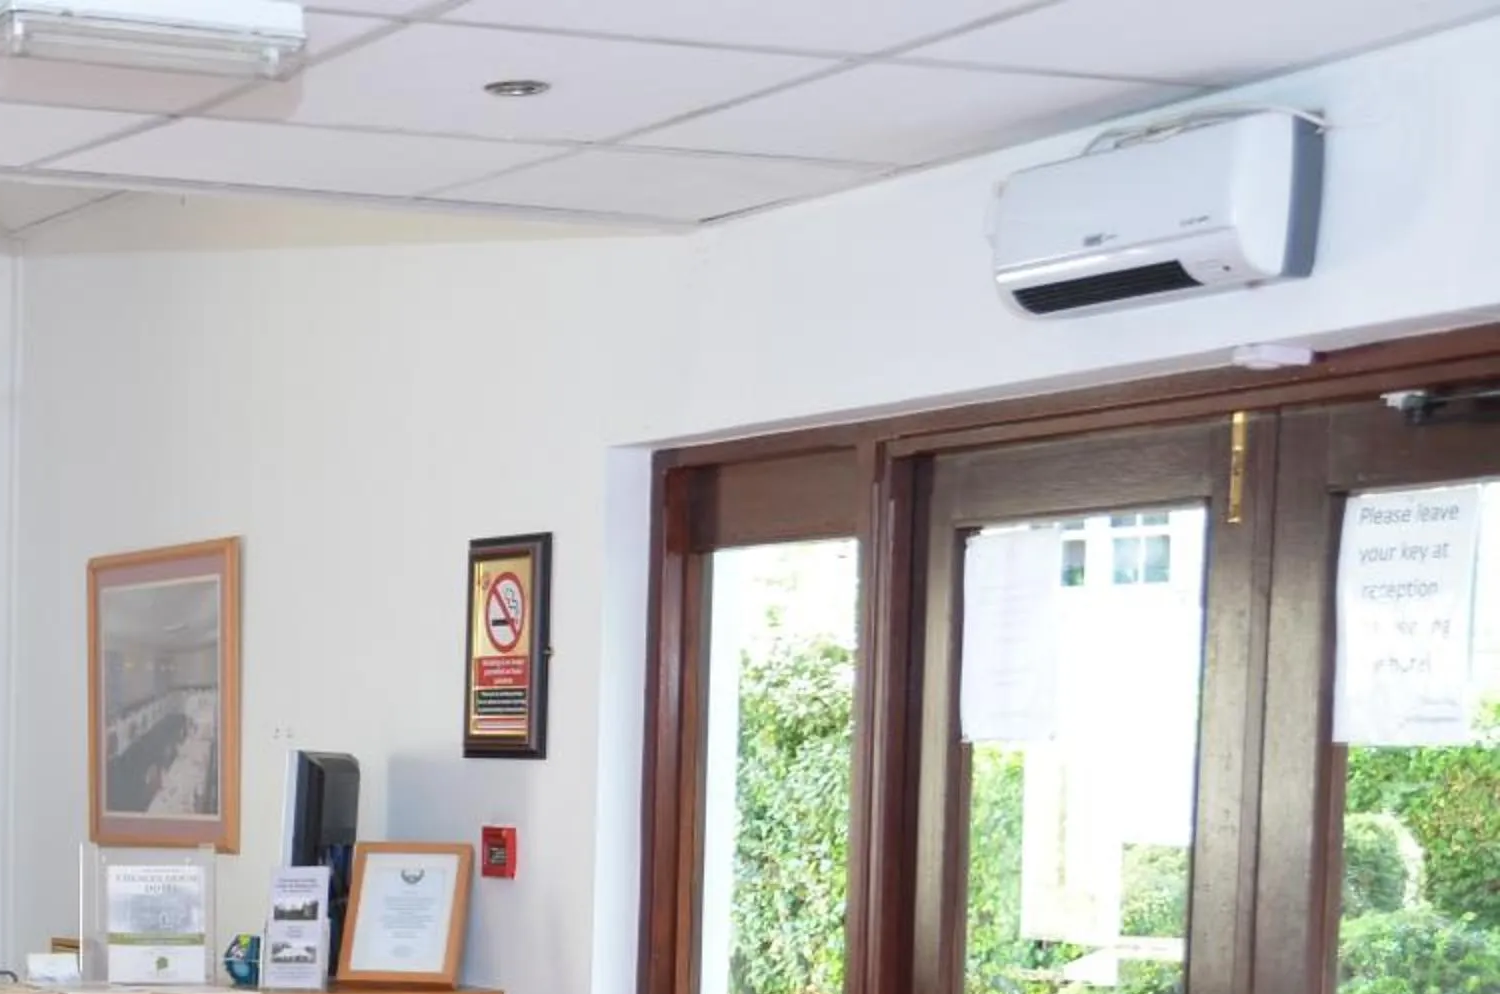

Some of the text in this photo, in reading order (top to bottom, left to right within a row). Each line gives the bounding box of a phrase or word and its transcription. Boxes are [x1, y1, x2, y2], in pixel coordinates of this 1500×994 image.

[1358, 502, 1460, 525] Please leave
[1358, 540, 1450, 564] your key at
